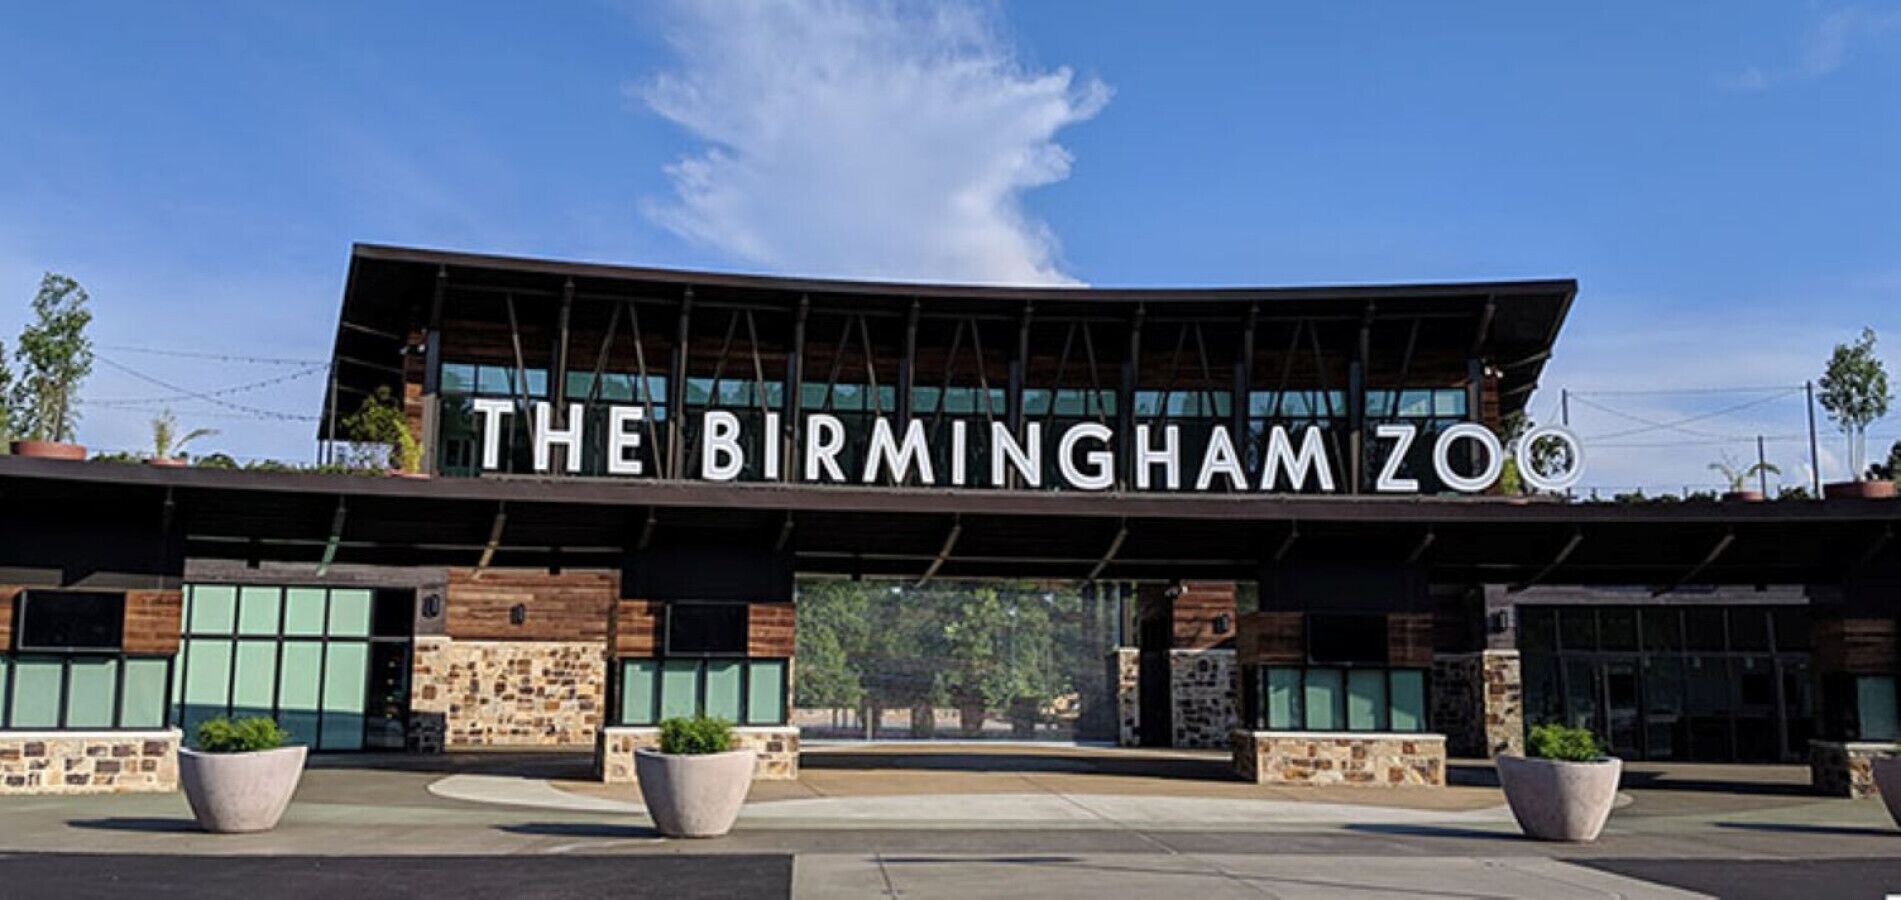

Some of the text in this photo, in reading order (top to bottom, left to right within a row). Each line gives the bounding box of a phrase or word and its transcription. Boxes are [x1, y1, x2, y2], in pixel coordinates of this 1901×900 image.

[473, 397, 1586, 493] THE BIRMINGHAM ZOO
